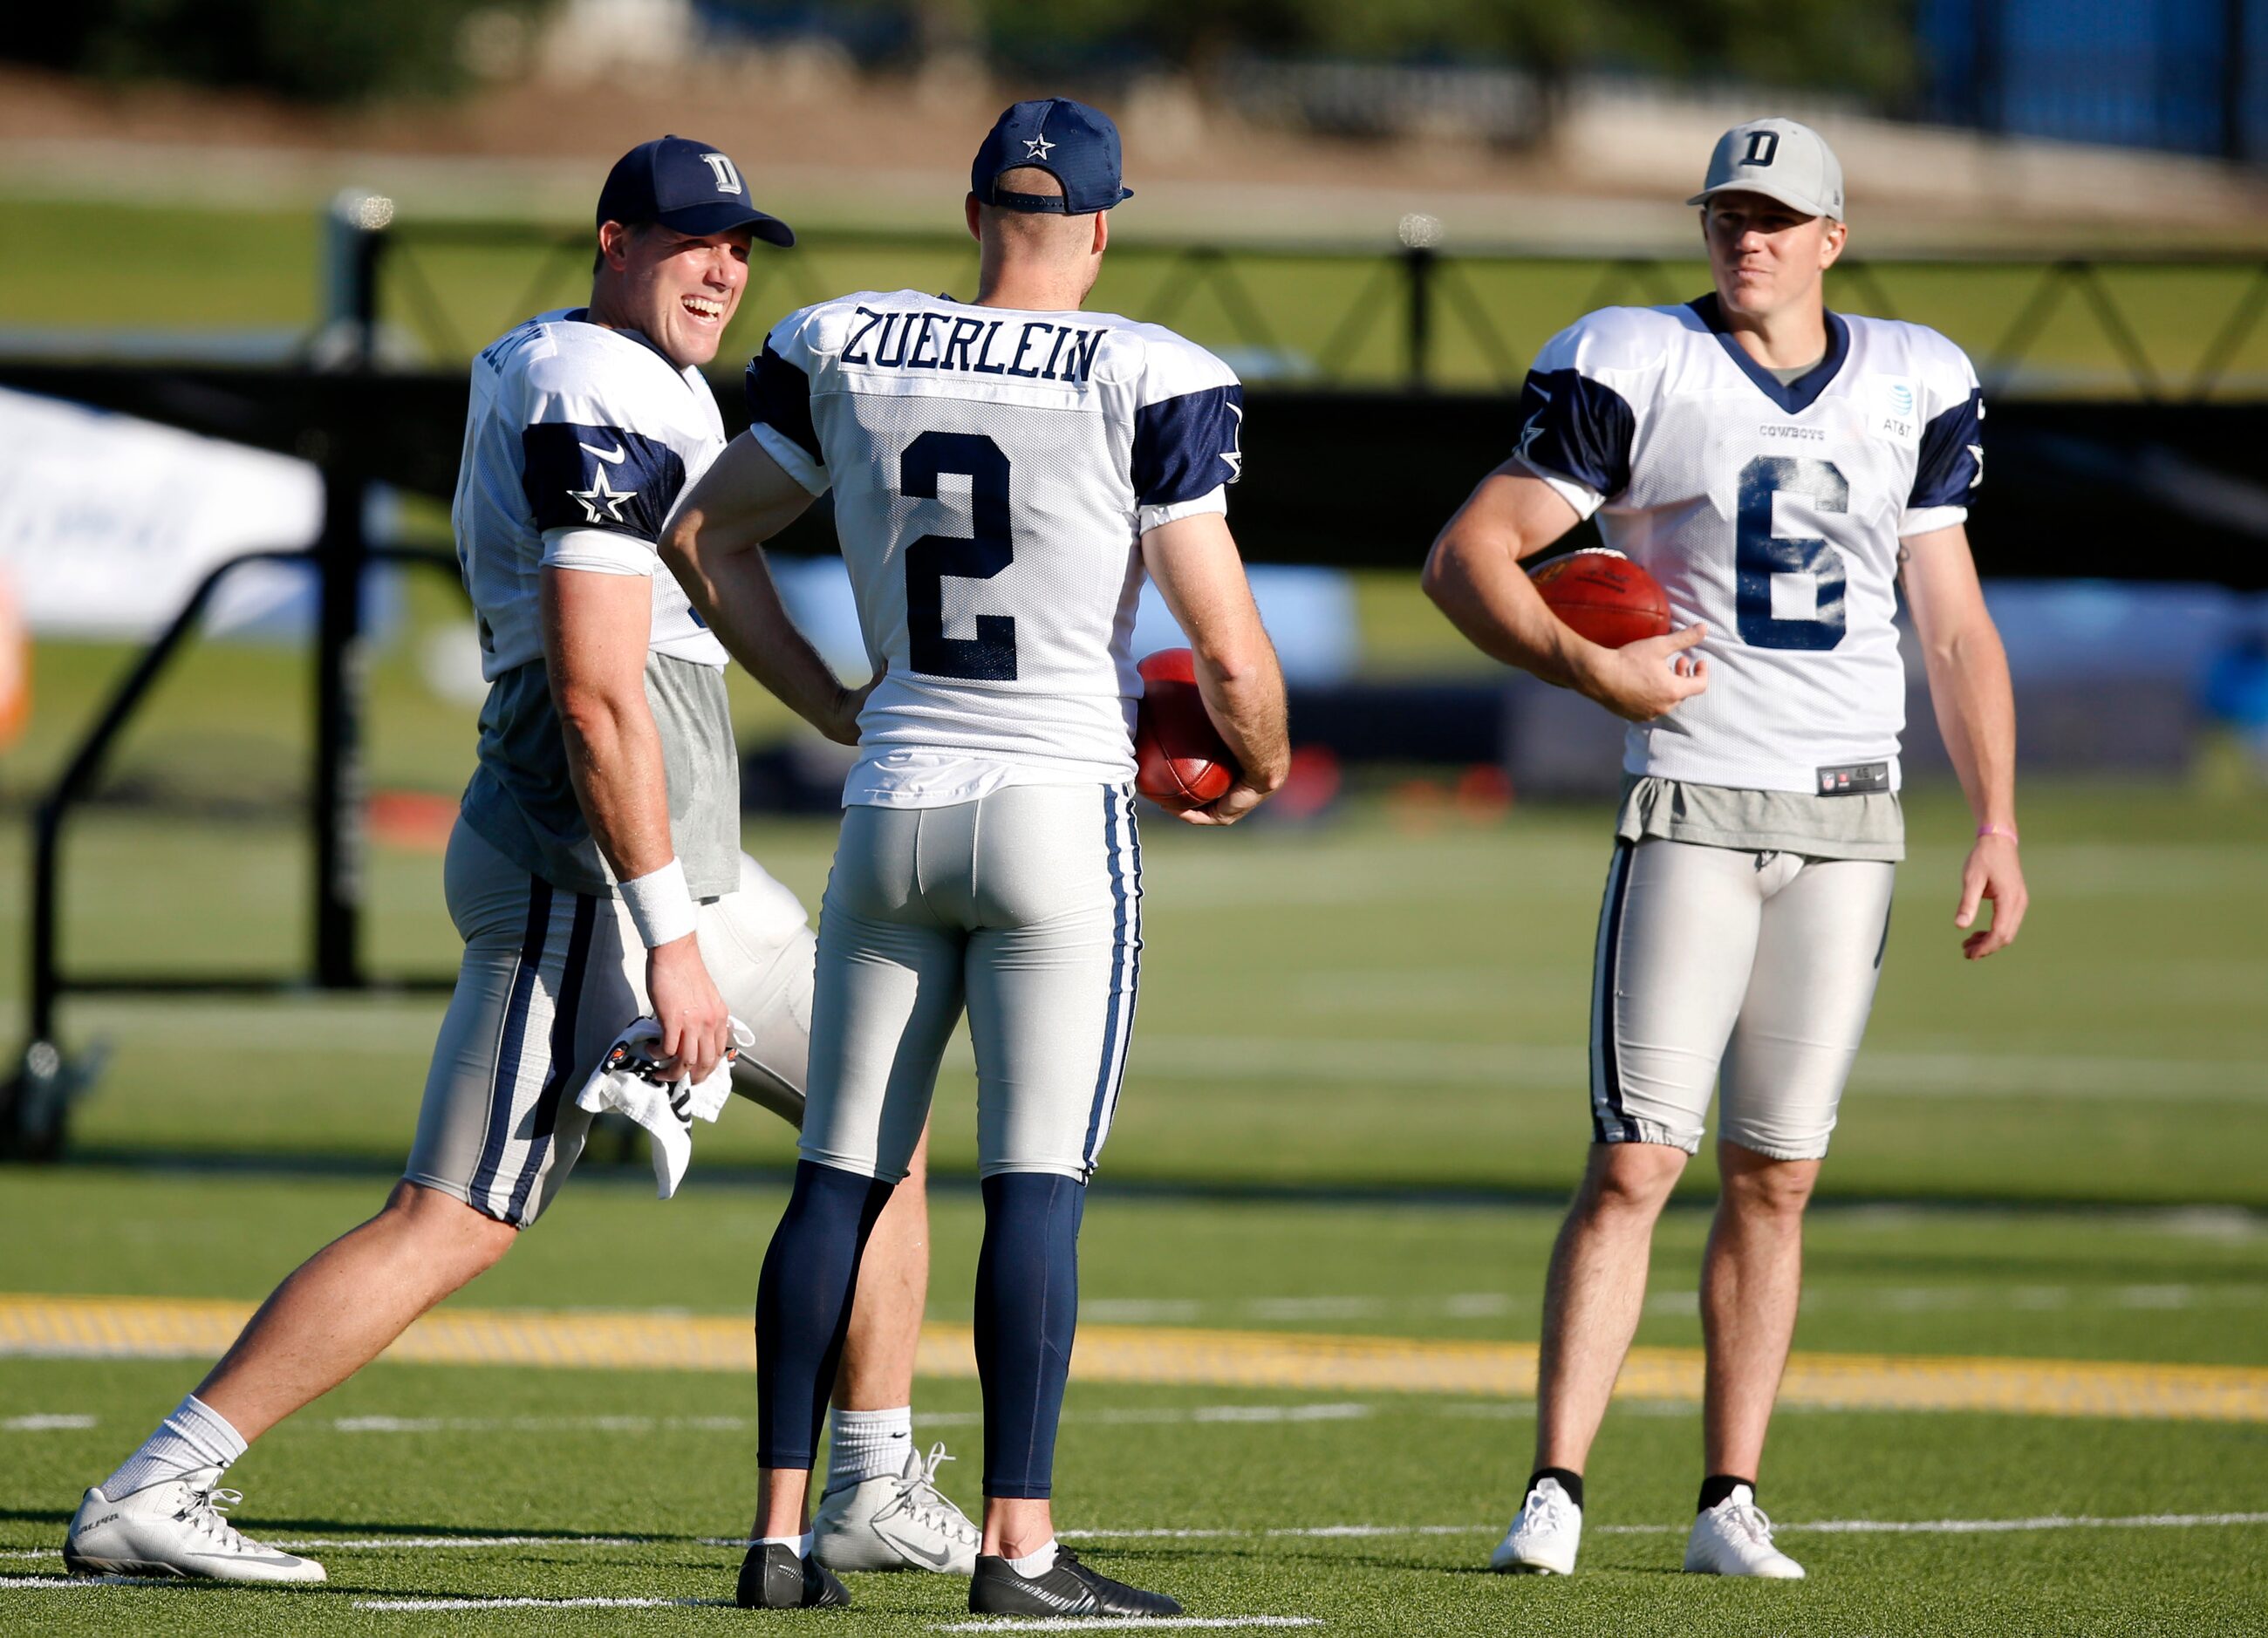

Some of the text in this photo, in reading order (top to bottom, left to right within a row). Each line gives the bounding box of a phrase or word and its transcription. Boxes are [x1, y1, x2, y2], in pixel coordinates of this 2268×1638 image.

[1739, 131, 1780, 167] D
[700, 153, 741, 195] D
[840, 306, 1109, 382] ZUERLEIN
[1759, 425, 1826, 440] COWBOYS
[1883, 419, 1913, 438] AT&T
[900, 430, 1018, 681] 2
[1736, 454, 1849, 651] 6
